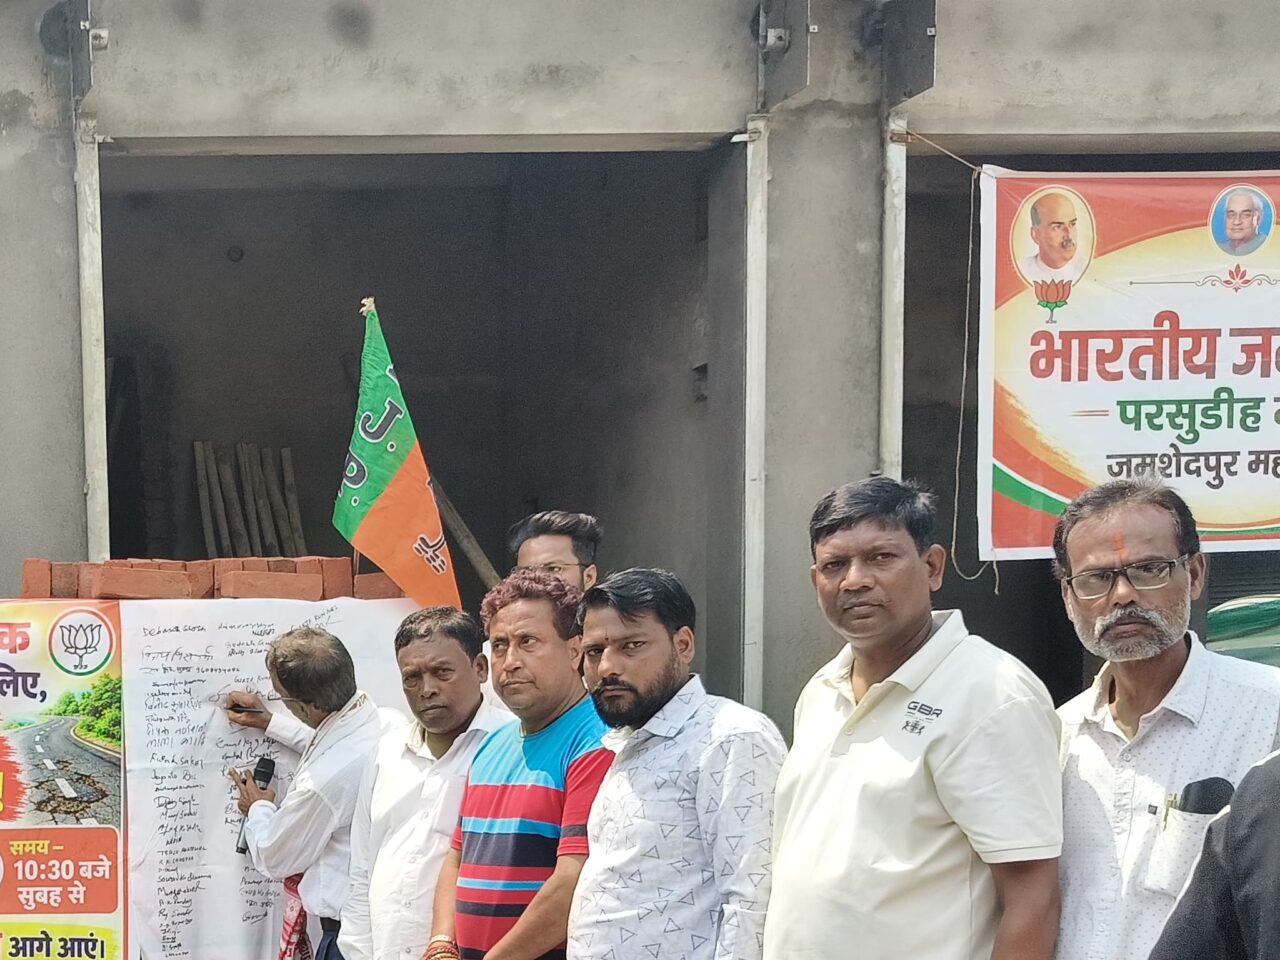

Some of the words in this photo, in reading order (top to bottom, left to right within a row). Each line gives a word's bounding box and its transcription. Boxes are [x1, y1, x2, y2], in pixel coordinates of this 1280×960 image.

[1029, 310, 1221, 382] भारतीय
[1230, 328, 1280, 378] ज
[1117, 387, 1265, 445] परसुडीह
[1107, 444, 1240, 488] जमशेदपुर
[14, 860, 74, 880] 10:30
[79, 854, 112, 879] बजे
[17, 887, 63, 910] सुबह
[67, 881, 86, 904] से
[9, 930, 52, 958] आगे
